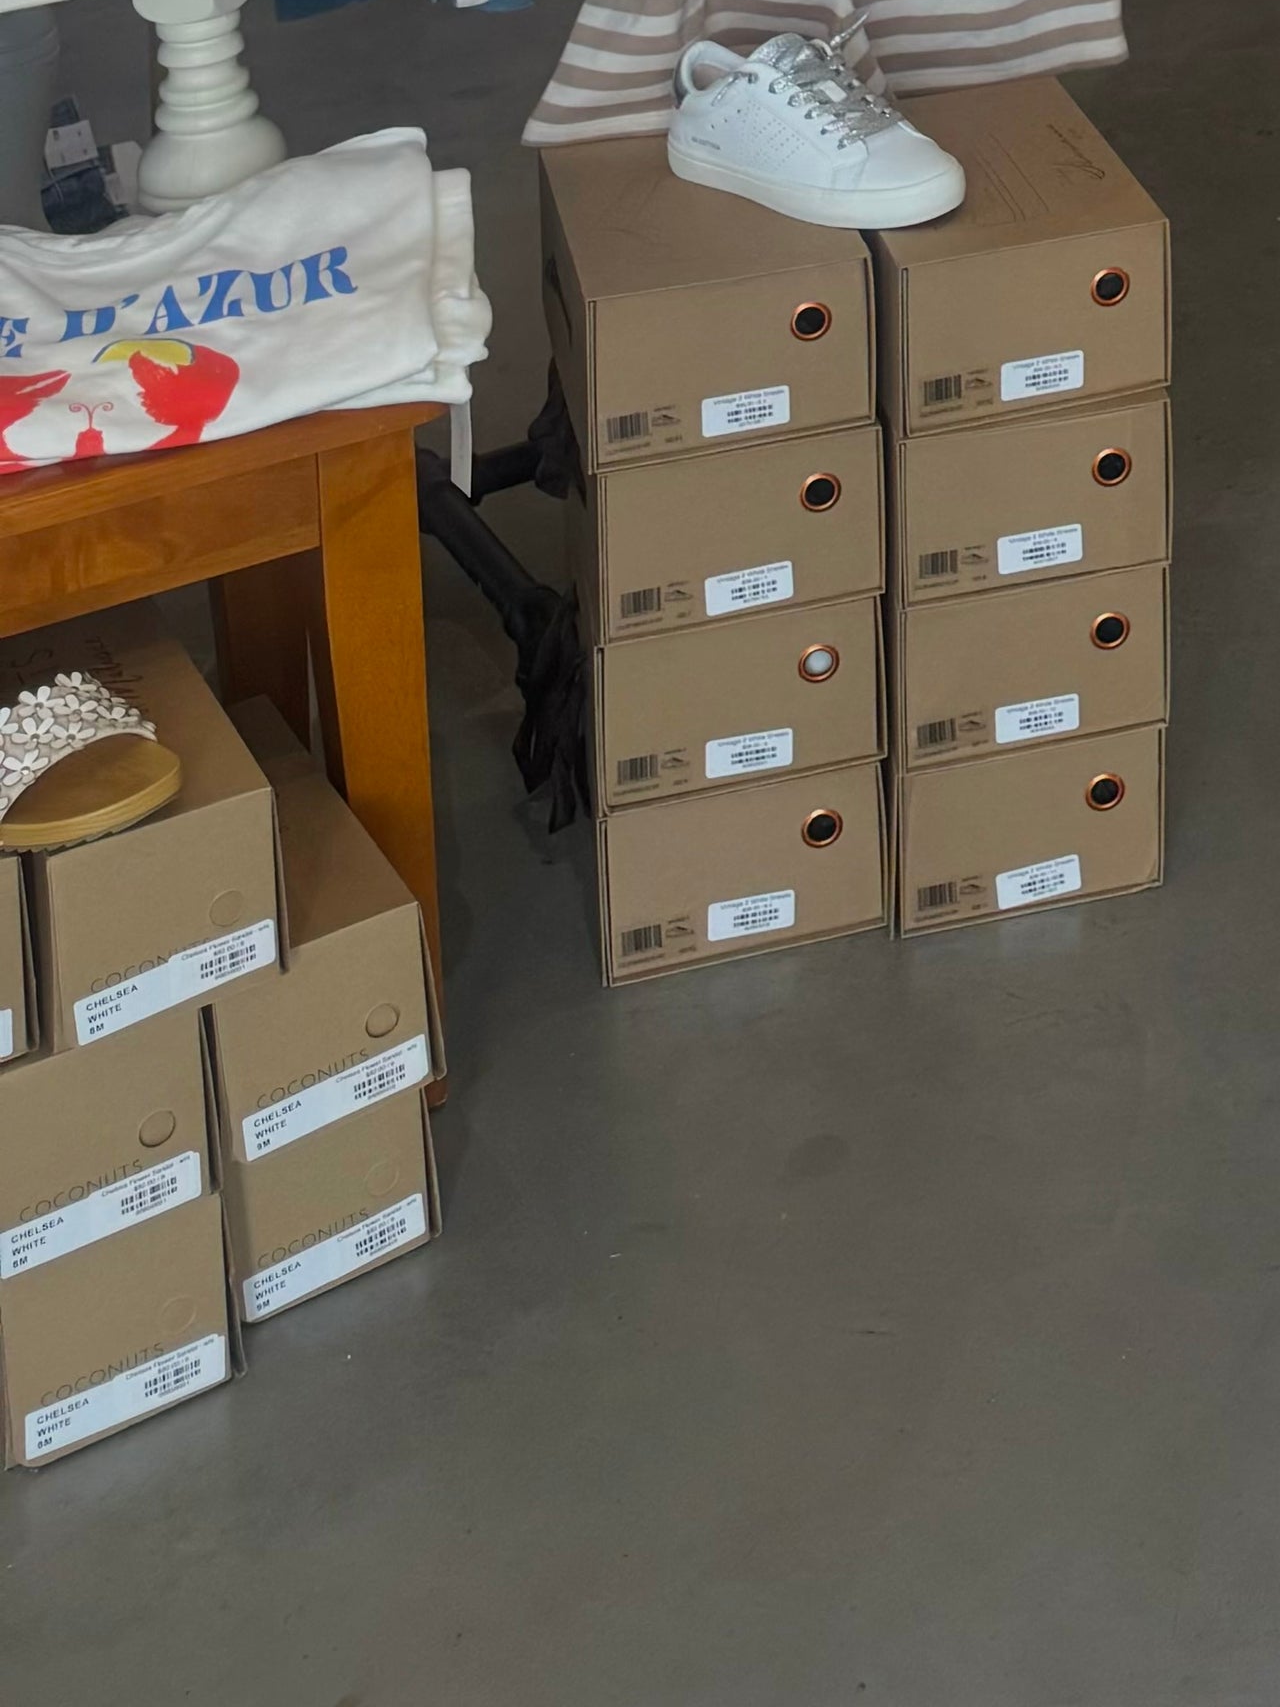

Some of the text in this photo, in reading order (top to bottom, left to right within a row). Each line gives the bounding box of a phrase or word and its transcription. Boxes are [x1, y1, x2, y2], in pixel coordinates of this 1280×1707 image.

[59, 246, 358, 342] D'AZUR
[90, 938, 209, 993] COCON
[86, 984, 138, 1011] CHELSEA
[88, 1003, 122, 1023] WHITE
[253, 1100, 302, 1128] CHELSEA
[254, 1119, 287, 1140] WHITE
[11, 1216, 64, 1244] CHELSEA
[12, 1236, 46, 1256] WHITE
[253, 1261, 302, 1289] CHELSEA
[255, 1280, 286, 1300] WHITE
[36, 1397, 90, 1424] CHELSEA
[37, 1417, 71, 1437] WHITE
